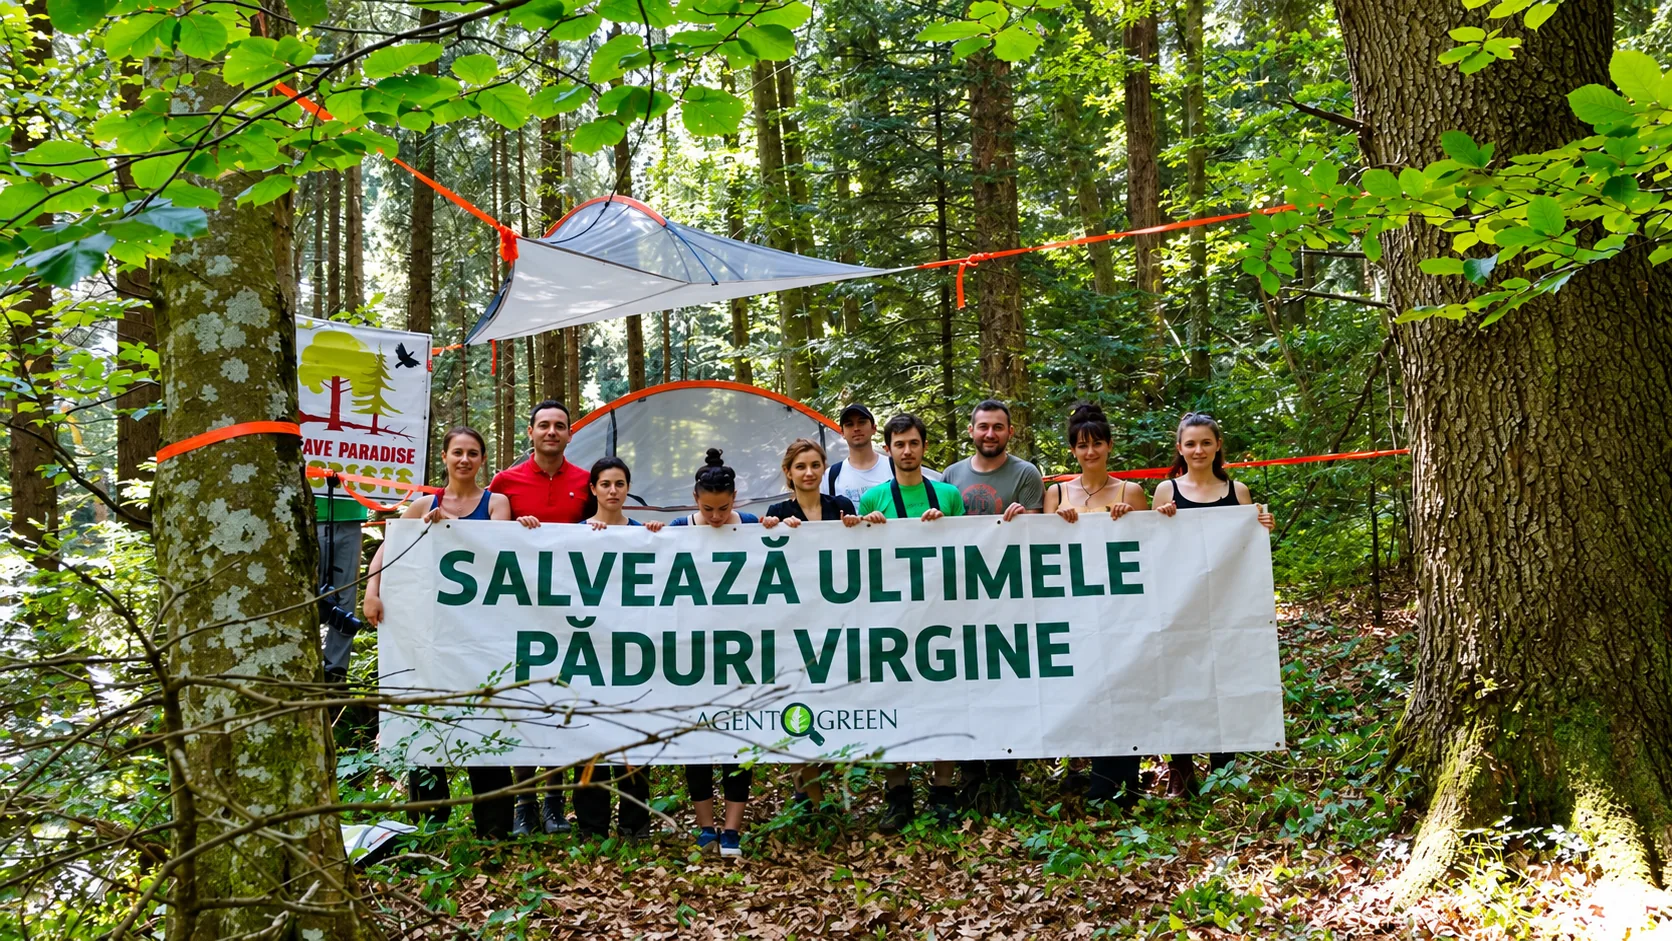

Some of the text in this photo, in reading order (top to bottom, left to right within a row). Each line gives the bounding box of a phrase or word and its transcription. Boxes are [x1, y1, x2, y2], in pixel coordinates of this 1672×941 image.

[302, 438, 416, 465] AVE PARADISE
[436, 535, 1144, 607] SALVEAZĂ ULTIMELE
[514, 615, 1074, 687] PĂDURI VIRGINE
[697, 708, 898, 731] AGENT GREEN
